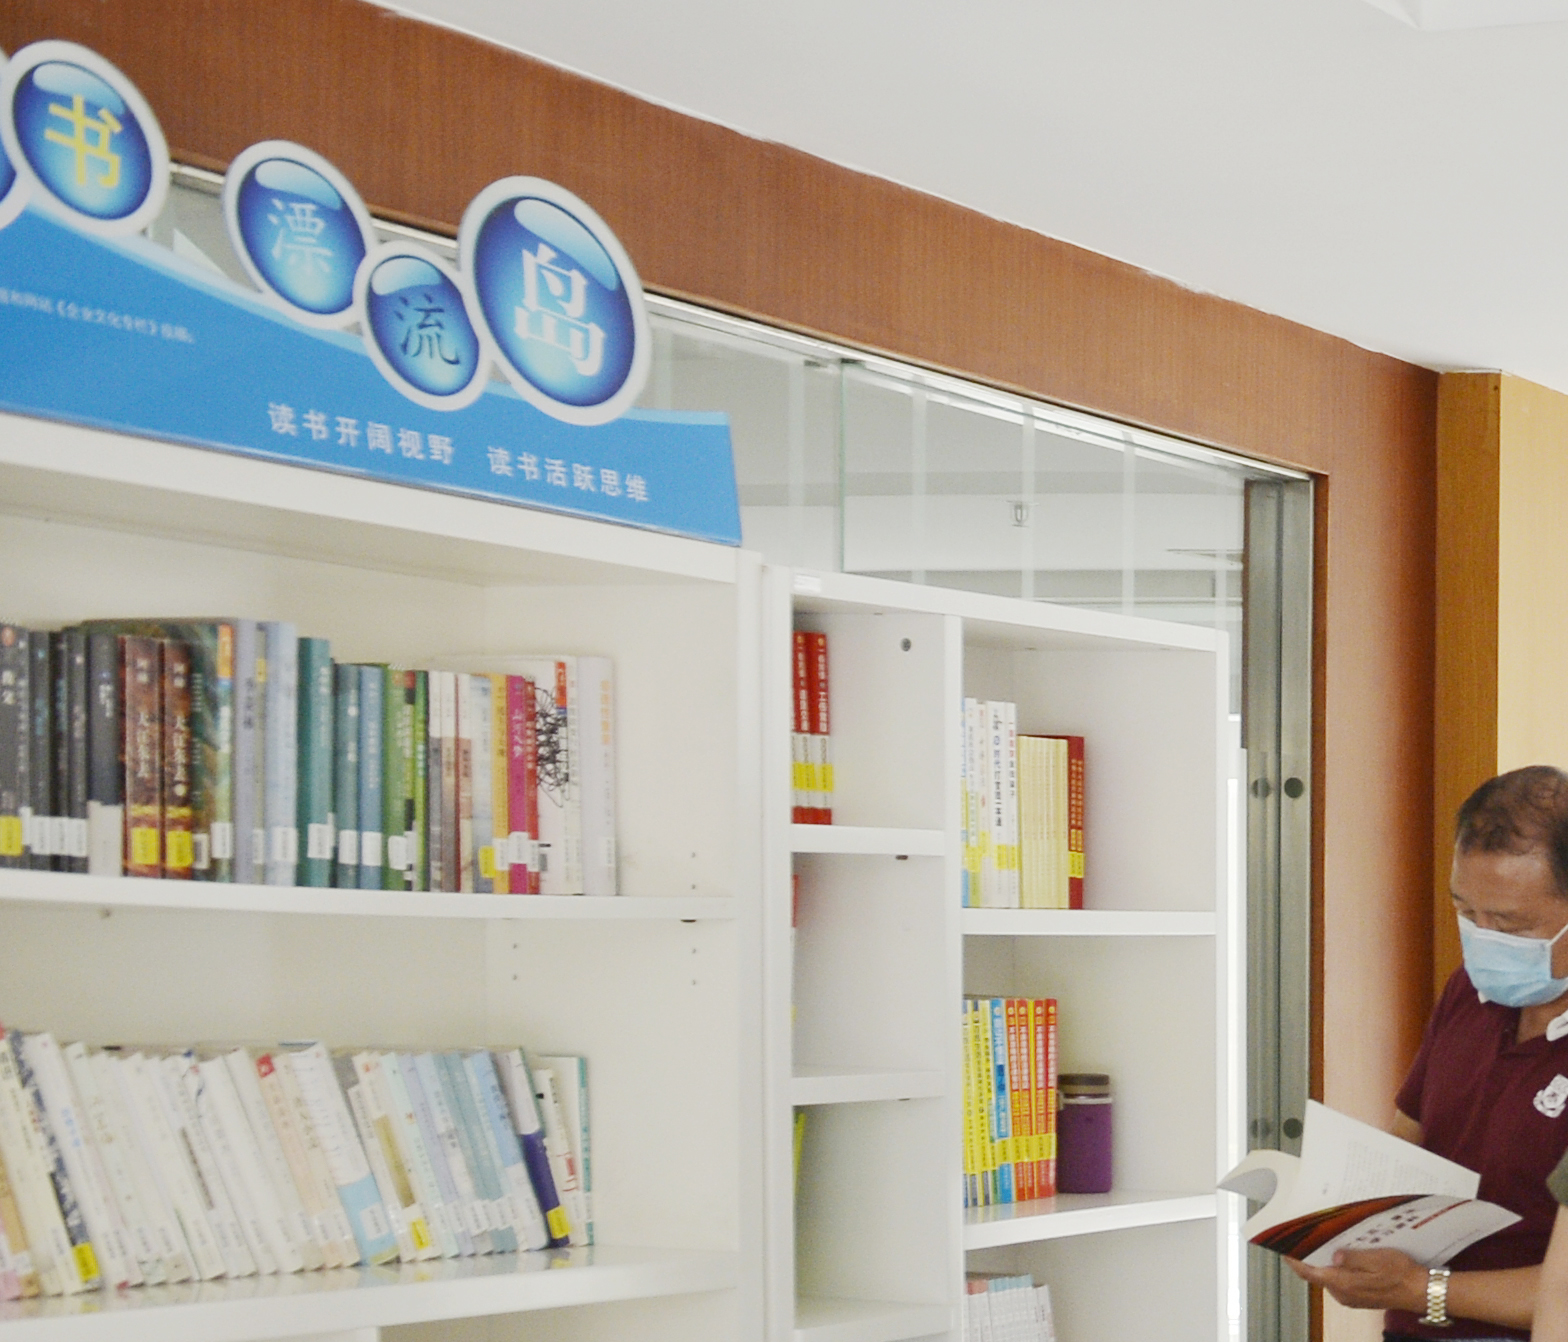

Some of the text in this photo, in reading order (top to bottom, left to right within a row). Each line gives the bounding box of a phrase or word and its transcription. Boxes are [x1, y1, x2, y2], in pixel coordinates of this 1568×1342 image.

[44, 94, 606, 379] 书 漂 流 岛
[266, 400, 650, 503] 读书开阔视野 读书活跃思维
